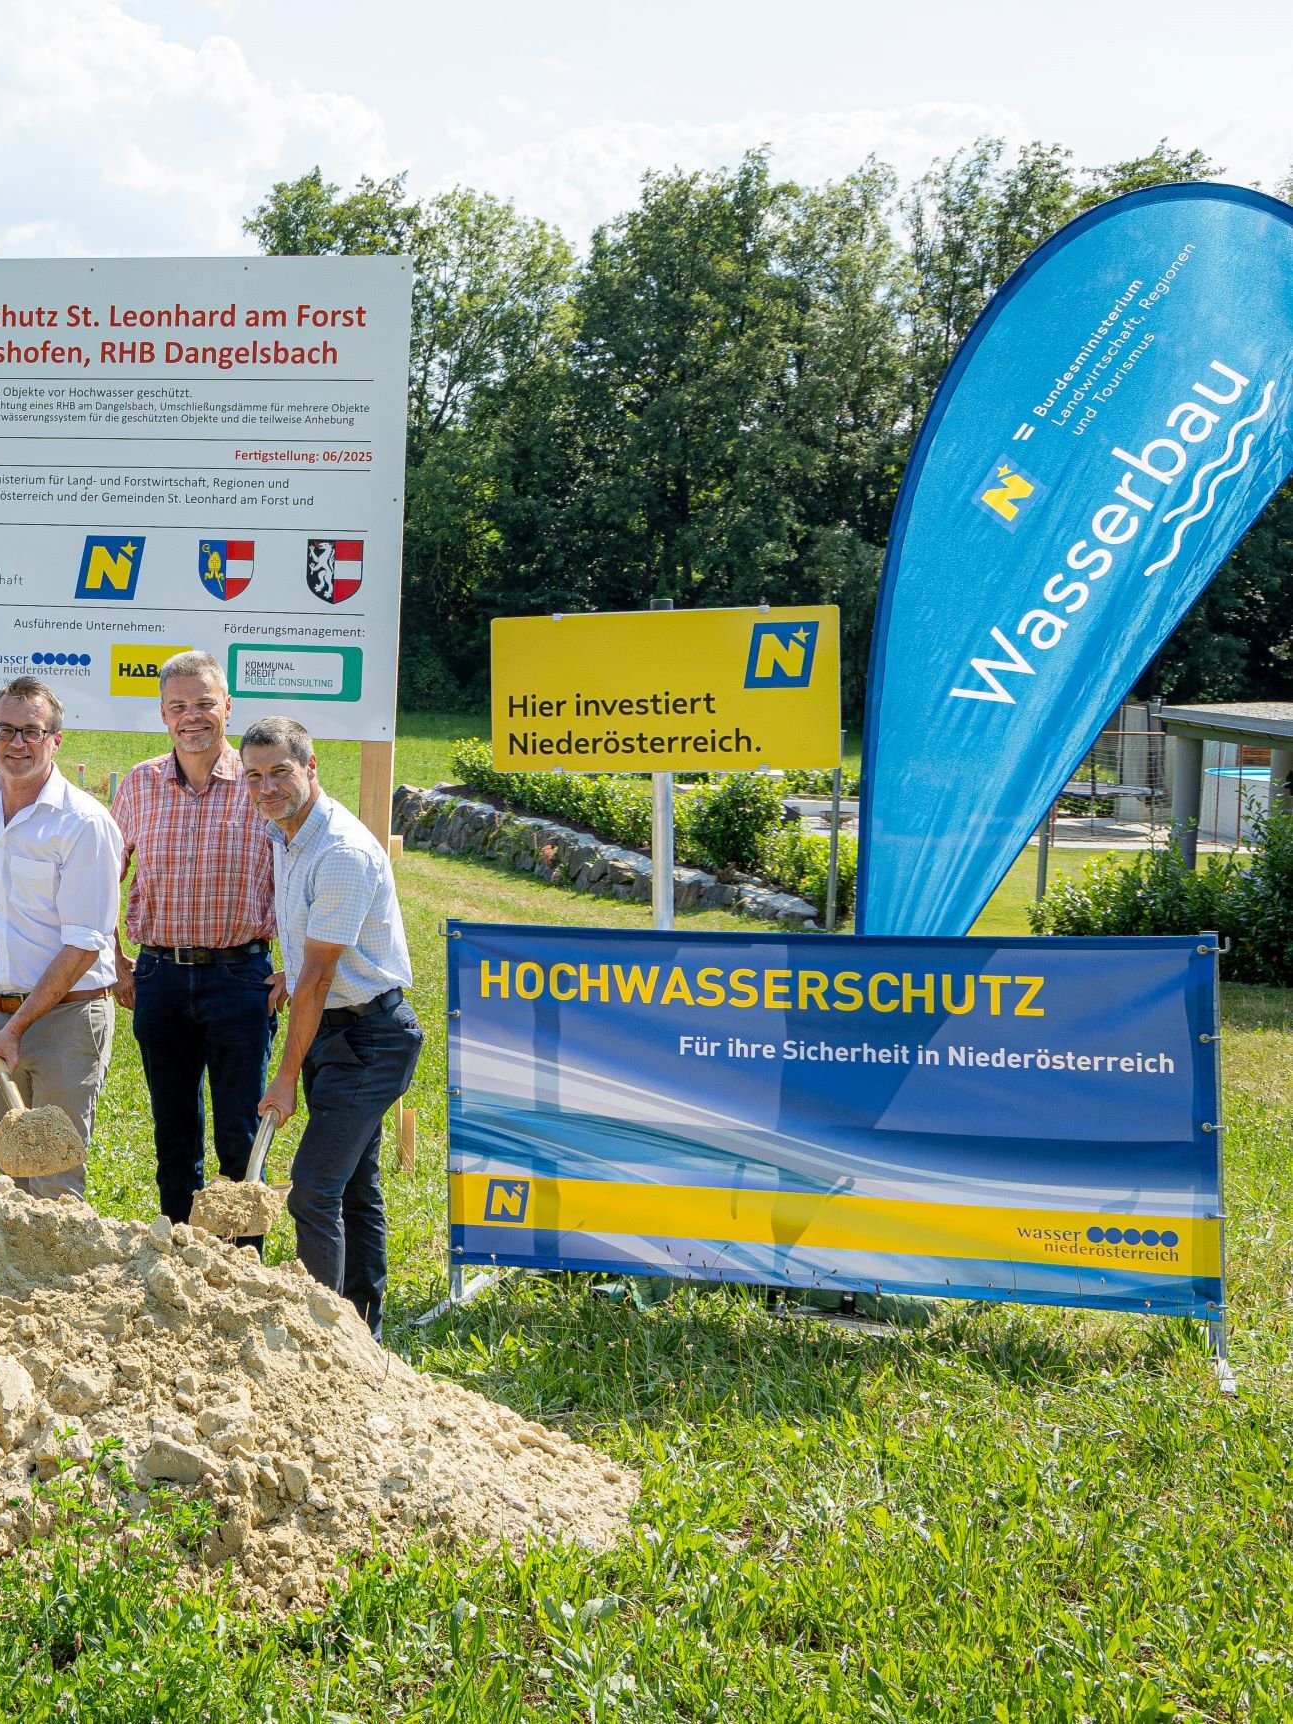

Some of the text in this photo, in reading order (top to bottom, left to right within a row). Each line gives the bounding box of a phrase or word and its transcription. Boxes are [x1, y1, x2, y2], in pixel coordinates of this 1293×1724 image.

[66, 305, 100, 328] St.
[110, 304, 235, 328] Leonhard
[245, 309, 286, 328] am
[298, 305, 366, 328] Forst
[1051, 243, 1196, 427] Landwirtschaft, Regionen
[100, 342, 155, 364] RHB
[165, 341, 338, 369] Dangelsbach
[1033, 279, 1143, 417] Bundesministerium
[1073, 332, 1155, 435] und Tourismus
[3, 387, 44, 400] Objekte
[48, 389, 66, 398] vor
[69, 387, 134, 398] Hochwasser
[137, 388, 192, 401] geschützt.
[29, 402, 53, 410] eines
[57, 402, 75, 410] RHB
[95, 402, 157, 414] Dangelsbach,
[160, 402, 267, 414] Umschließungsdämme
[270, 403, 285, 412] für
[287, 404, 328, 413] mehrere
[331, 403, 370, 415] Objekte
[89, 413, 102, 422] für
[104, 413, 119, 422] die
[122, 413, 178, 426] geschützten
[181, 414, 218, 426] Objekte
[221, 414, 239, 424] und
[242, 414, 256, 424] die
[259, 414, 302, 424] teilweise
[305, 415, 355, 426] Anhebung
[235, 450, 372, 463] Fertigstellung: 06/2025
[49, 475, 66, 485] für
[68, 475, 97, 486] Land-
[100, 475, 120, 486] und
[124, 476, 209, 489] Forstwirtschaft,
[213, 478, 265, 491] Regionen
[268, 478, 289, 489] und
[57, 491, 77, 502] und
[80, 492, 99, 502] der
[101, 492, 165, 504] Gemeinden
[168, 493, 181, 504] St.
[185, 494, 236, 505] Leonhard
[240, 497, 257, 505] am
[261, 495, 288, 505] Forst
[292, 495, 314, 506] und
[949, 359, 1251, 704] Wasserbau
[14, 618, 165, 633] Ausführende Unternehmen:
[224, 623, 365, 639] Förderungsmanagement:
[3, 663, 91, 677] niederösterreich
[118, 663, 160, 678] HAB
[245, 661, 295, 670] KOMMUNAL
[245, 670, 275, 678] KREDIT
[244, 677, 333, 688] PUBLIC CONSULTING
[508, 691, 716, 718] Hier investiert
[508, 727, 762, 755] Niederösterreich.
[480, 960, 1044, 1017] HOCHWASSERSCHUTZ
[680, 1036, 1174, 1074] Für ihre Sicherheit in Niederösterreich
[1017, 1227, 1081, 1242] wasser
[1044, 1242, 1179, 1262] niederösterreich
